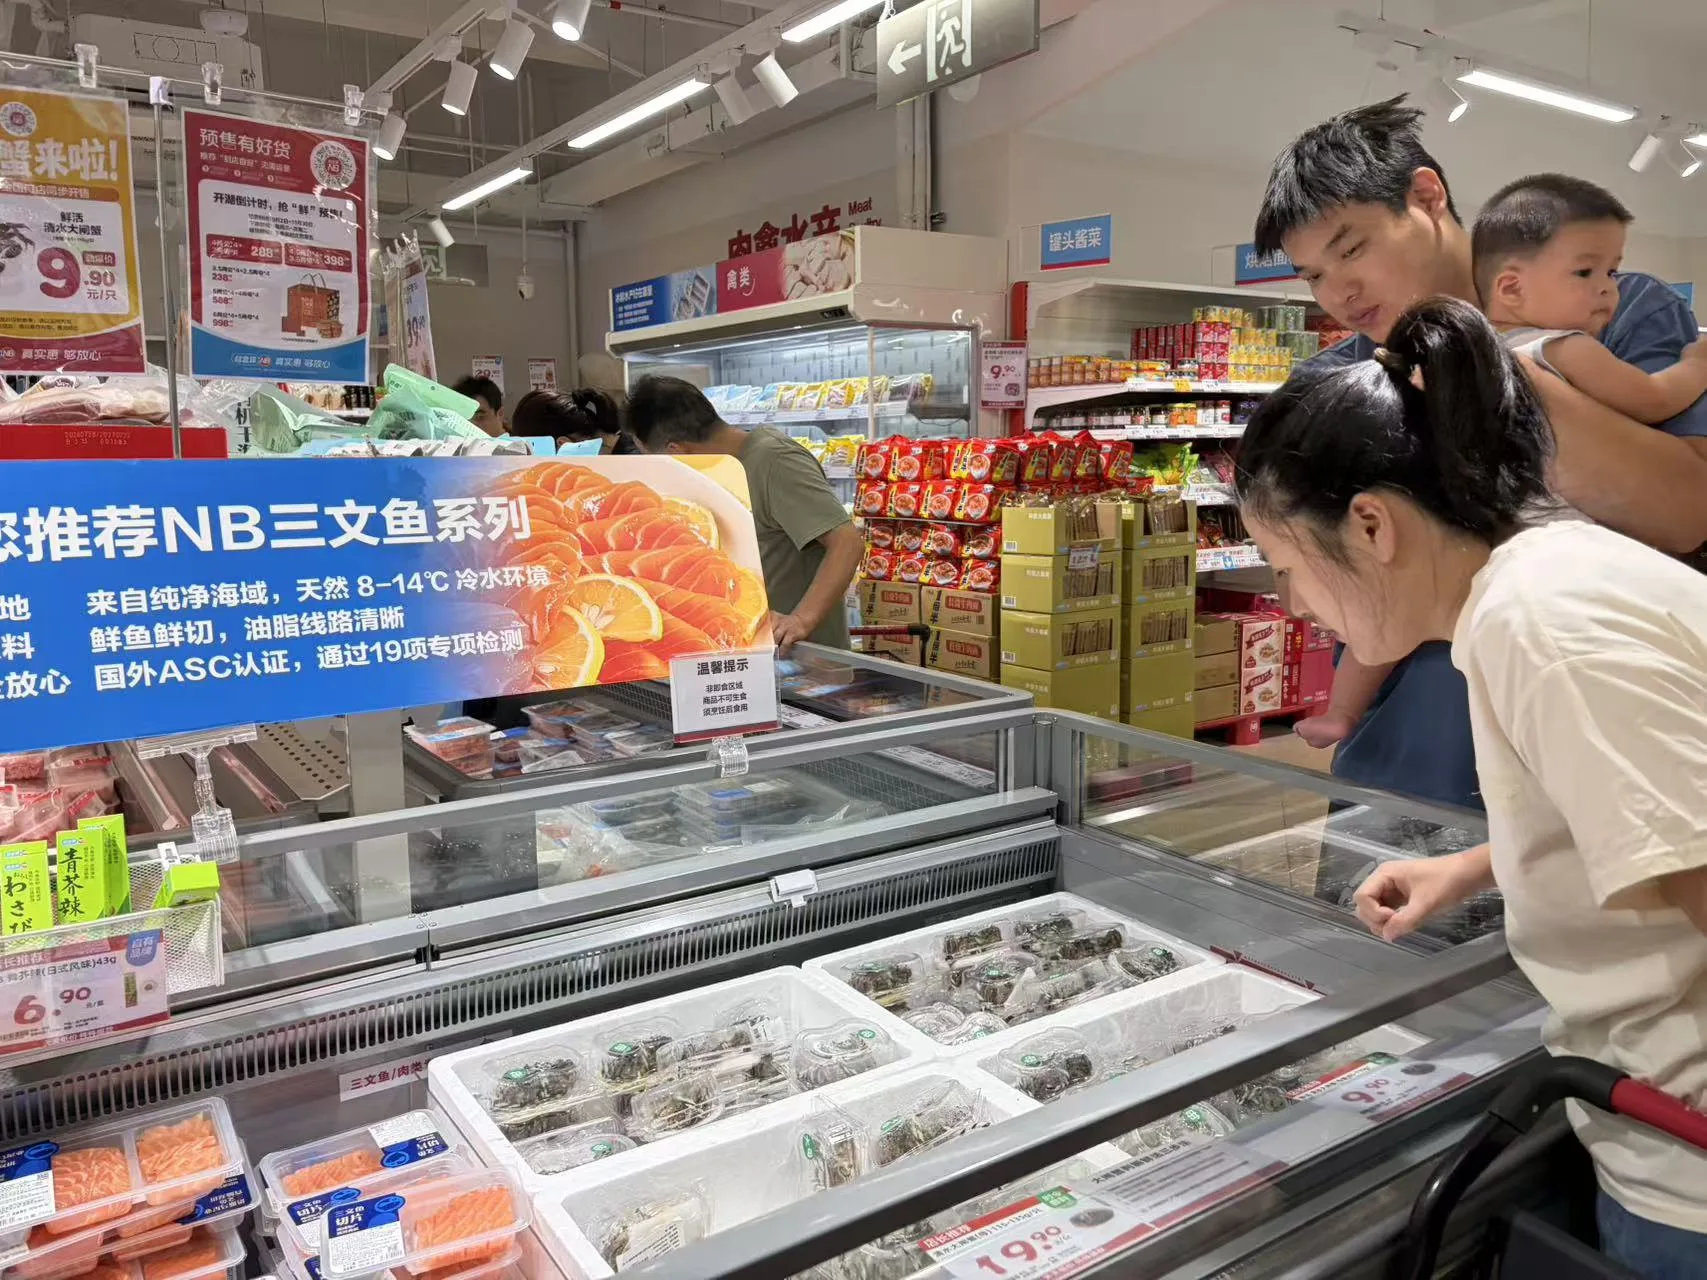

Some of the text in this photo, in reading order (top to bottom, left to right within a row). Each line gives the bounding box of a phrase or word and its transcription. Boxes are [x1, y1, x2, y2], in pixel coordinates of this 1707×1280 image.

[200, 128, 291, 160] 预售有好货
[60, 211, 84, 223] 鲜活
[848, 197, 873, 216] Meat
[1049, 227, 1103, 252] 罐头酱菜
[323, 255, 345, 267] 398
[212, 273, 229, 282] 238
[455, 565, 550, 591] 冷水环境
[697, 658, 749, 676] 温馨提示
[0, 669, 72, 701] 放心
[705, 681, 743, 693] 非即食区域
[702, 692, 747, 705] 商品不可生食
[58, 848, 85, 917] 青芥辣
[0, 952, 45, 970] 长推荐
[14, 986, 92, 1025] 6.90
[351, 1060, 431, 1090] 三文鱼/肉类
[925, 1225, 972, 1250] 店长推荐
[976, 1226, 1062, 1275] 19.90
